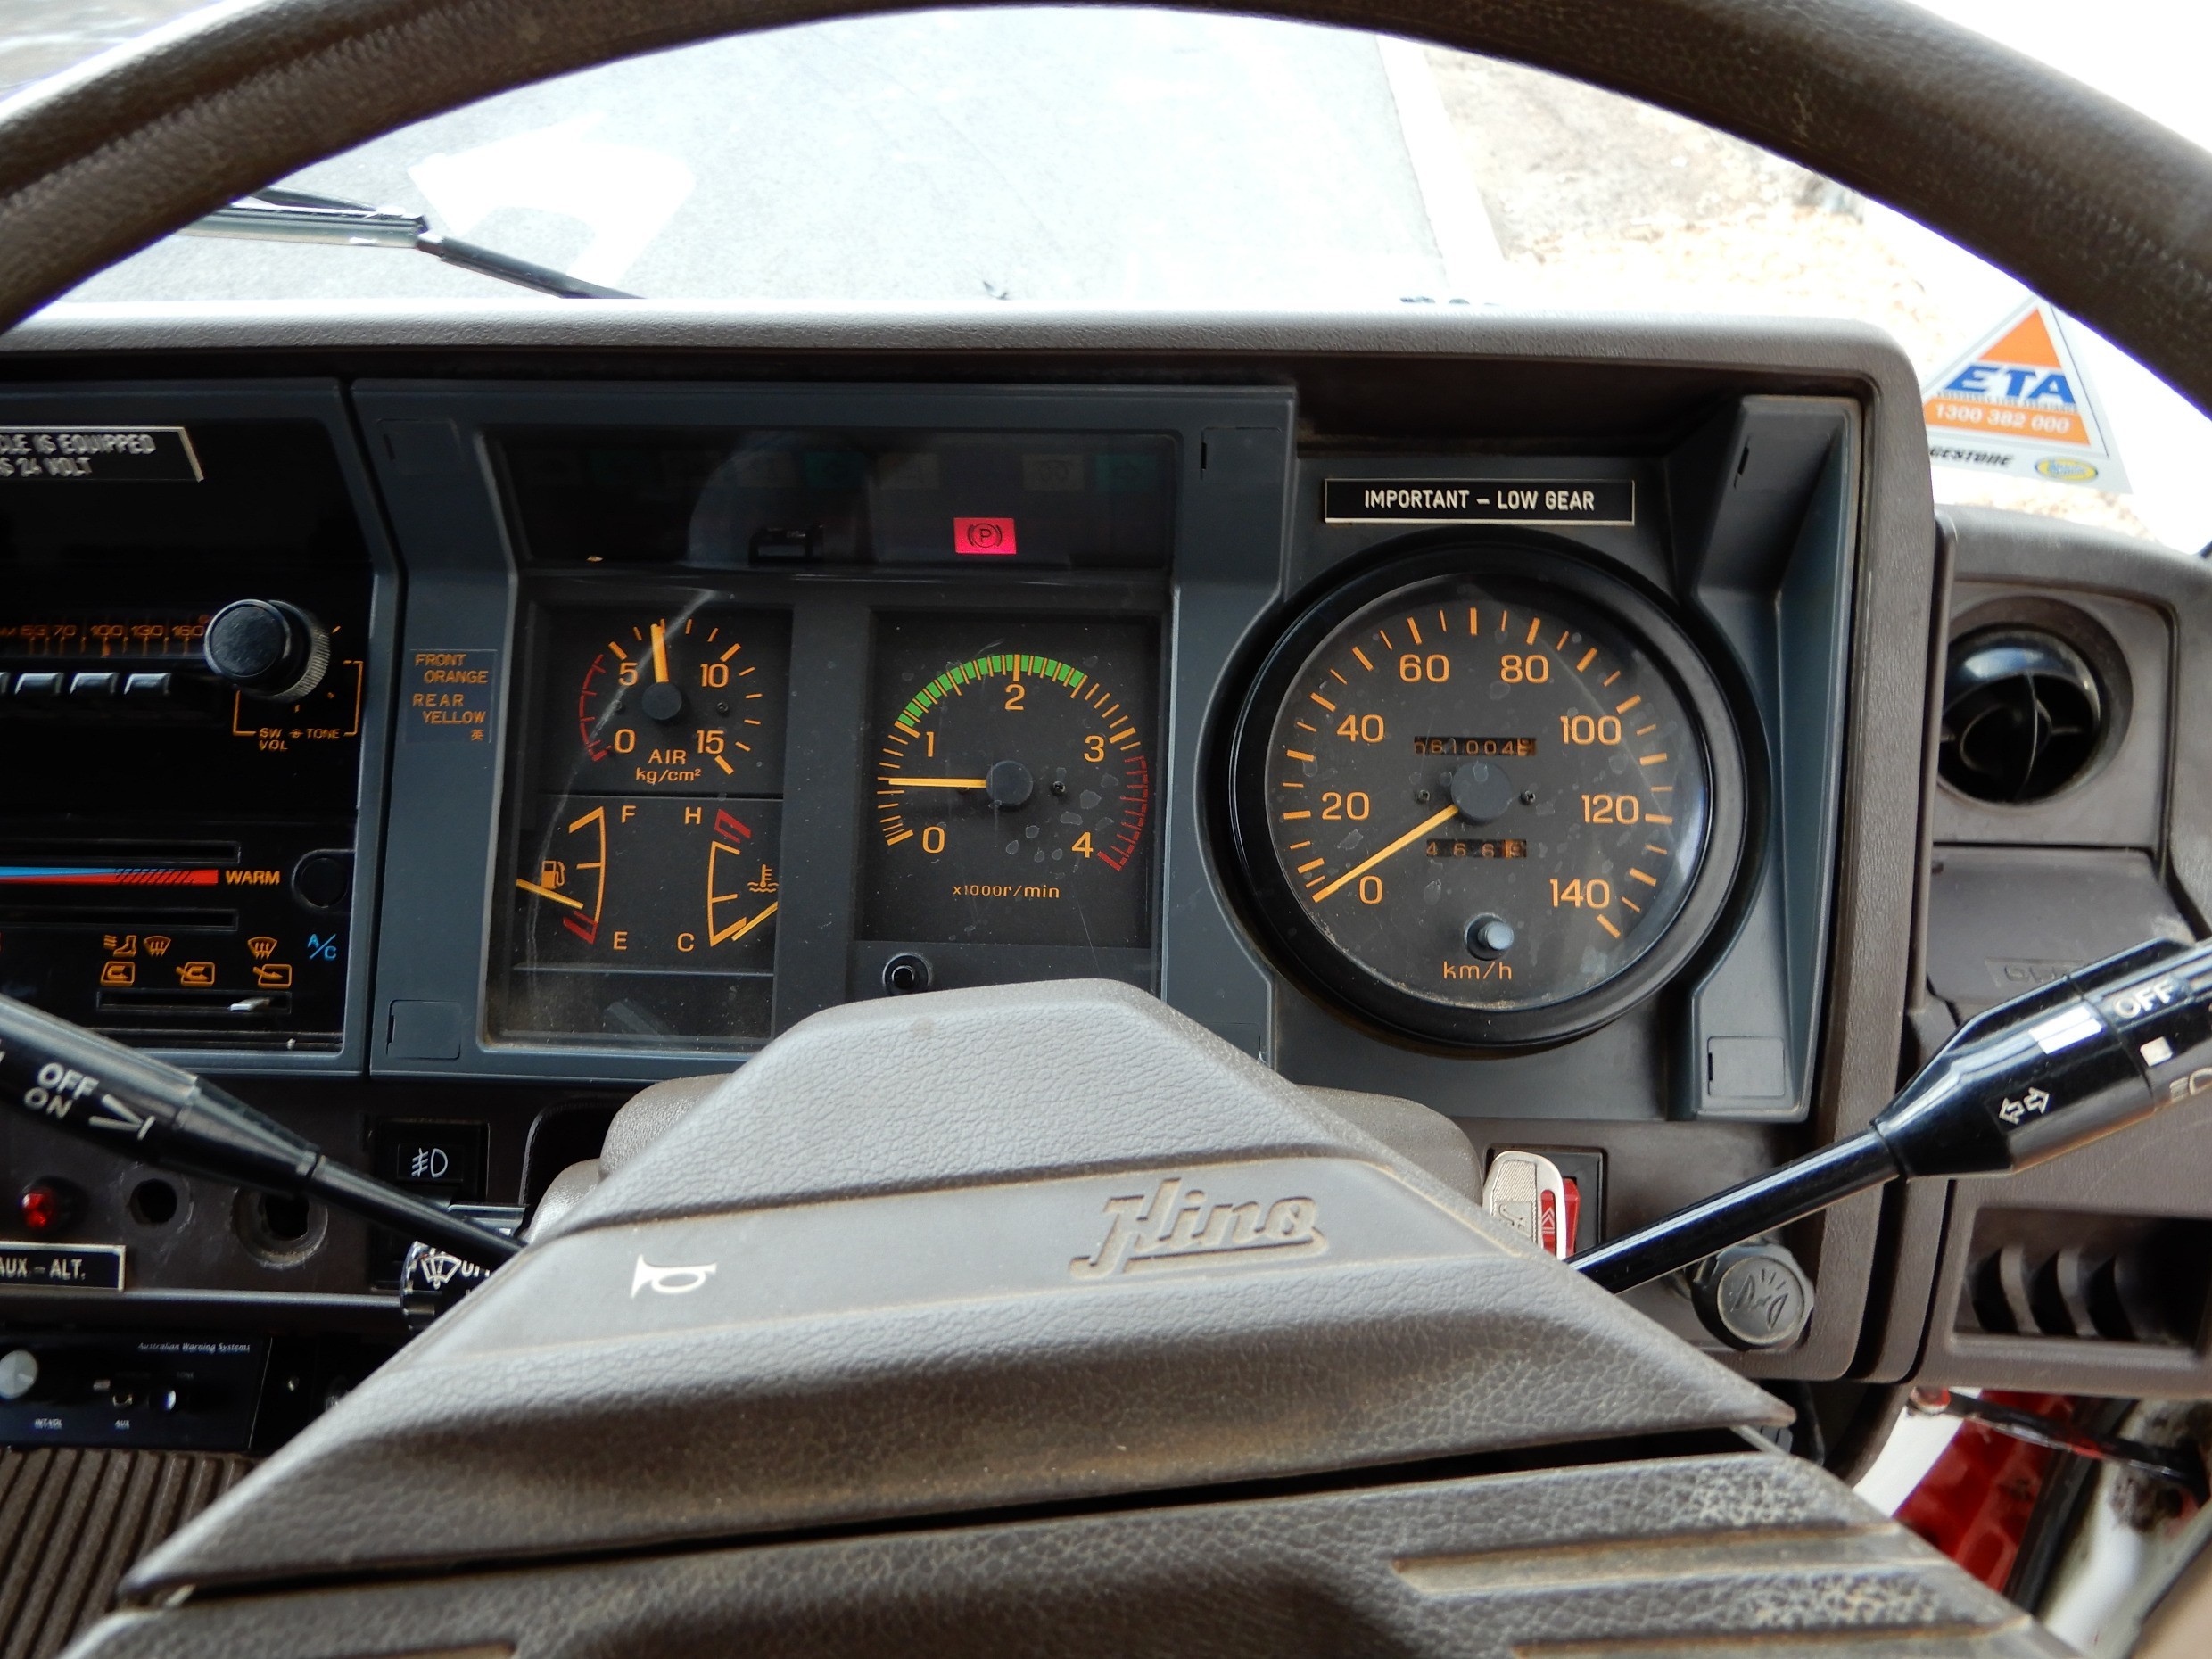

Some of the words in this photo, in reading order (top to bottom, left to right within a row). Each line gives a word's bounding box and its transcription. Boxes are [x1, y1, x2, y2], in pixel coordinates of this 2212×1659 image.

[1944, 365, 2076, 405] ETA
[1936, 403, 1983, 423] 1300
[1987, 409, 2026, 429] 382
[2031, 415, 2070, 434] 000
[57, 434, 156, 455] EQUIPPED
[44, 457, 92, 477] VOLT
[1365, 489, 1470, 510] IMPORTANT
[1497, 491, 1539, 510] LOW
[1545, 491, 1596, 512] GEAR
[90, 625, 123, 637] 100
[415, 653, 467, 667] FRONT
[1399, 655, 1450, 683] 60
[1499, 654, 1549, 684] 80
[424, 669, 490, 684] ORANGE
[618, 662, 639, 686] 5
[699, 663, 730, 689] 10
[412, 693, 465, 707] REAR
[1004, 683, 1025, 711] 2
[422, 710, 487, 725] YELLOW
[1336, 714, 1385, 744] 40
[1560, 714, 1622, 745] 100
[259, 739, 288, 753] VOL
[260, 727, 283, 739] SW
[306, 728, 341, 740] TONE
[614, 729, 637, 754] 0
[697, 730, 725, 755] 15
[925, 731, 935, 758] 1
[648, 748, 687, 765] AIR
[1083, 735, 1106, 763] 3
[621, 805, 636, 823] F
[684, 806, 702, 825] H
[1321, 791, 1371, 821] 20
[1582, 794, 1640, 825] 120
[922, 826, 946, 854] 0
[1072, 831, 1094, 859] 4
[225, 869, 281, 886] WARM
[1359, 875, 1383, 905] 0
[1549, 878, 1612, 910] 140
[307, 933, 338, 961] A/C
[613, 931, 628, 950] E
[677, 932, 695, 952] C
[1442, 960, 1514, 981] km/h
[2113, 978, 2175, 1019] OFF
[37, 1062, 100, 1101] OFF
[24, 1087, 73, 1118] ON
[1069, 1177, 1328, 1279] Hino
[138, 1342, 180, 1351] Australian
[182, 1342, 216, 1354] Warning
[218, 1342, 251, 1353] Systems
